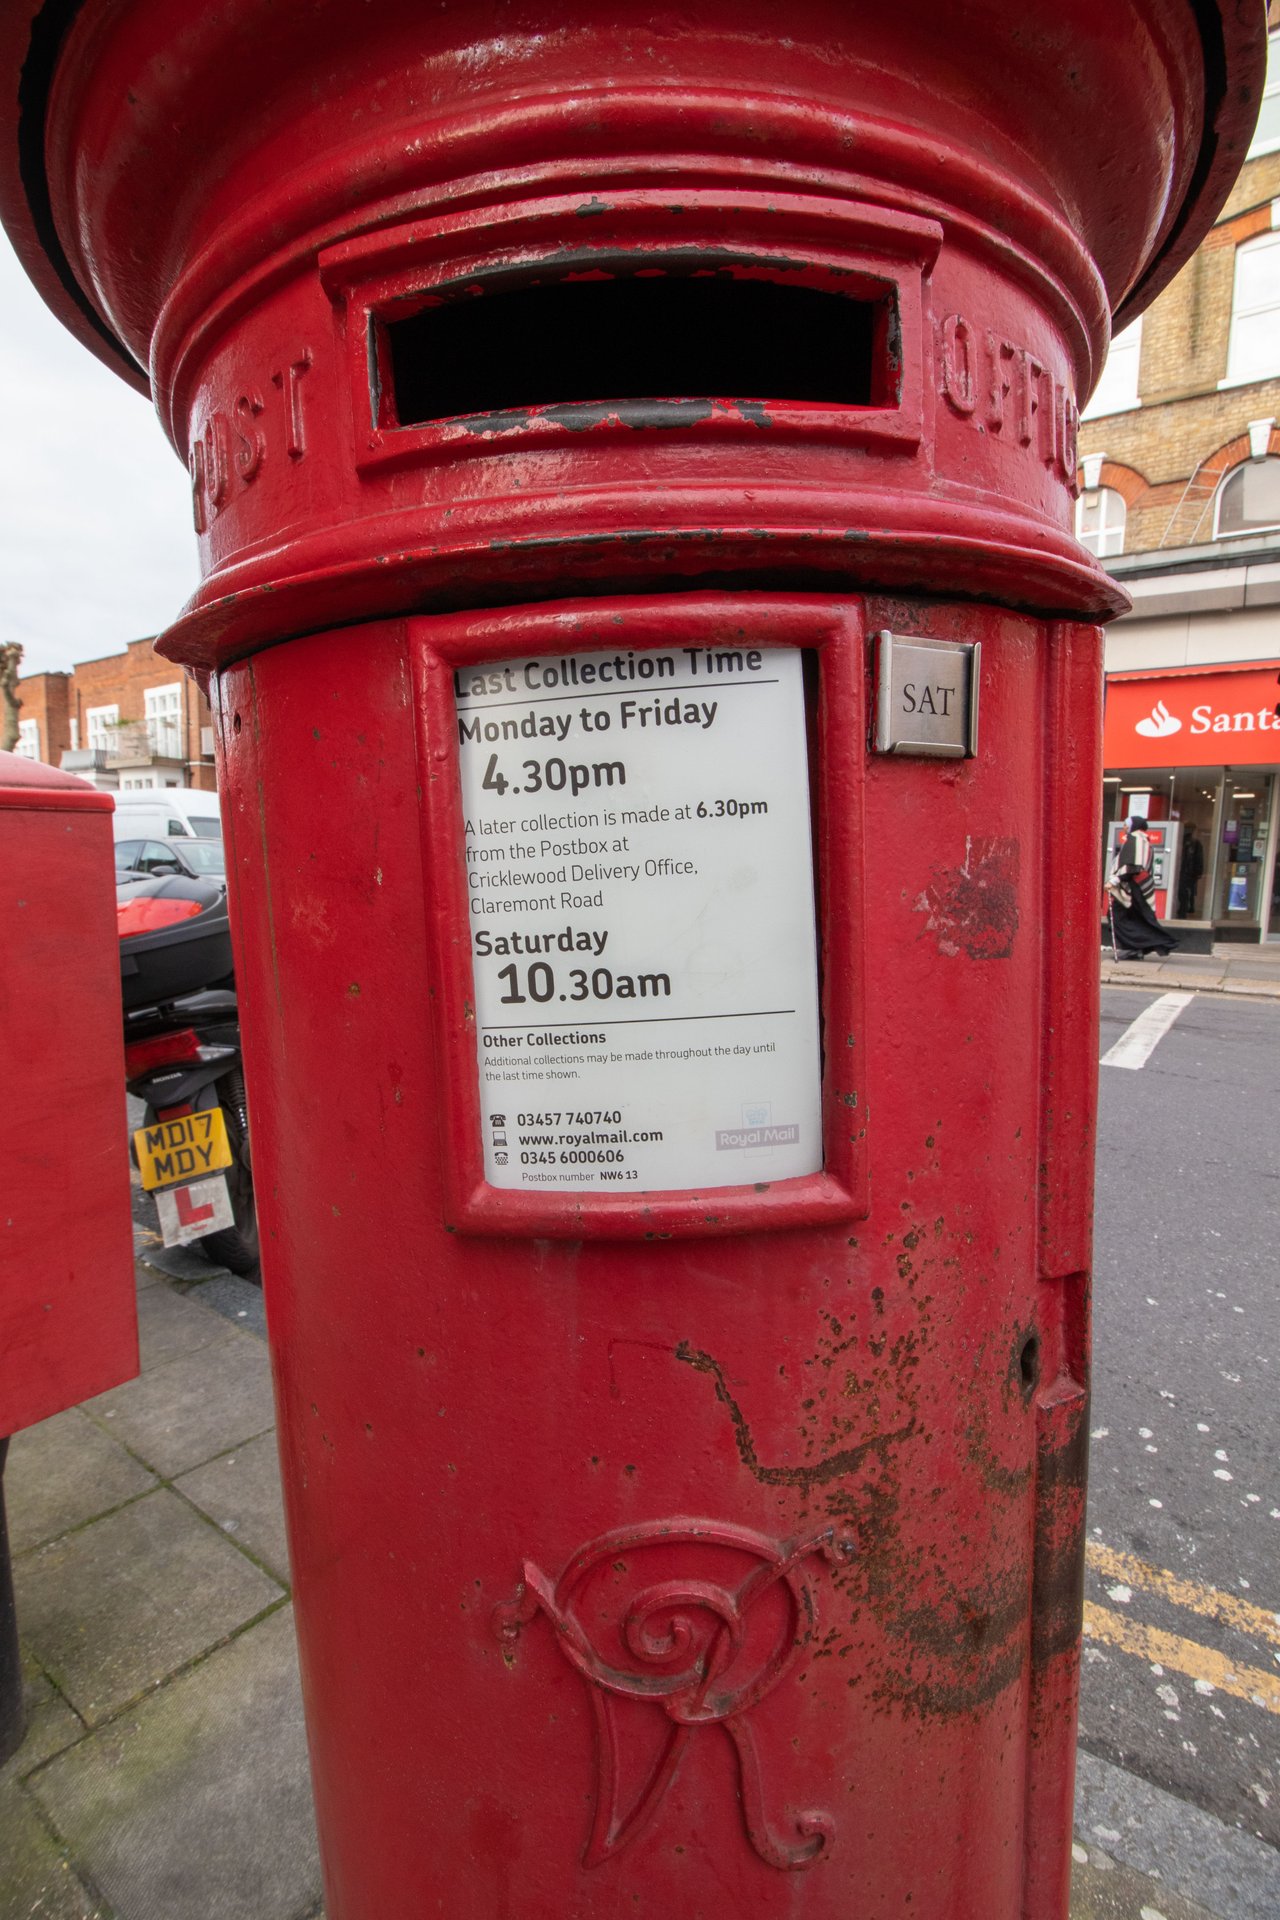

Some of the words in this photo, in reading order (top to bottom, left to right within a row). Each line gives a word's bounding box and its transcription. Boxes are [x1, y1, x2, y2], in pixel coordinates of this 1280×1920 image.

[941, 314, 1080, 500] OFFIC
[454, 668, 517, 698] Last
[524, 652, 675, 690] Collection
[683, 648, 762, 675] Time
[903, 683, 955, 716] SAT
[458, 711, 571, 745] Monday
[580, 708, 611, 732] to
[620, 698, 718, 729] Friday
[482, 753, 626, 797] 4.30pm
[465, 820, 476, 836] A
[479, 819, 516, 835] later
[521, 812, 599, 832] collection
[603, 809, 617, 825] is
[621, 805, 670, 824] made
[674, 804, 692, 820] at
[696, 799, 768, 819] 6.30pm
[466, 846, 505, 862] from
[509, 843, 536, 859] the
[540, 838, 608, 857] Postbox
[612, 836, 629, 852] at
[469, 866, 567, 888] Cricklewood
[571, 863, 640, 882] Delivery
[644, 858, 698, 877] Office,
[471, 895, 556, 914] Claremont
[561, 890, 603, 909] Road
[475, 926, 609, 956] Saturday
[497, 962, 671, 1004] 10.30am
[483, 1034, 523, 1048] Other
[527, 1031, 606, 1046] Collections
[484, 1055, 531, 1066] Additional
[534, 1054, 584, 1065] collections
[586, 1053, 608, 1064] may
[610, 1052, 622, 1062] be
[625, 1050, 653, 1061] made
[655, 1047, 712, 1060] throughout
[714, 1046, 731, 1056] the
[733, 1044, 751, 1056] day
[753, 1042, 776, 1053] until
[485, 1071, 501, 1081] the
[503, 1071, 520, 1081] last
[522, 1070, 543, 1080] time
[545, 1069, 580, 1080] shown.
[517, 1112, 562, 1126] 03457
[566, 1110, 622, 1125] 740740
[145, 1113, 212, 1154] MD17
[518, 1130, 663, 1147] www.royalmail.com
[720, 1130, 760, 1146] Royal
[764, 1127, 795, 1142] Mail
[153, 1141, 213, 1181] MDY
[520, 1151, 556, 1164] 0345
[560, 1150, 625, 1164] 6000606
[522, 1172, 557, 1182] Postbox
[559, 1171, 595, 1181] number
[600, 1171, 623, 1181] NW6
[625, 1170, 638, 1180] 13
[174, 1186, 214, 1227] L
